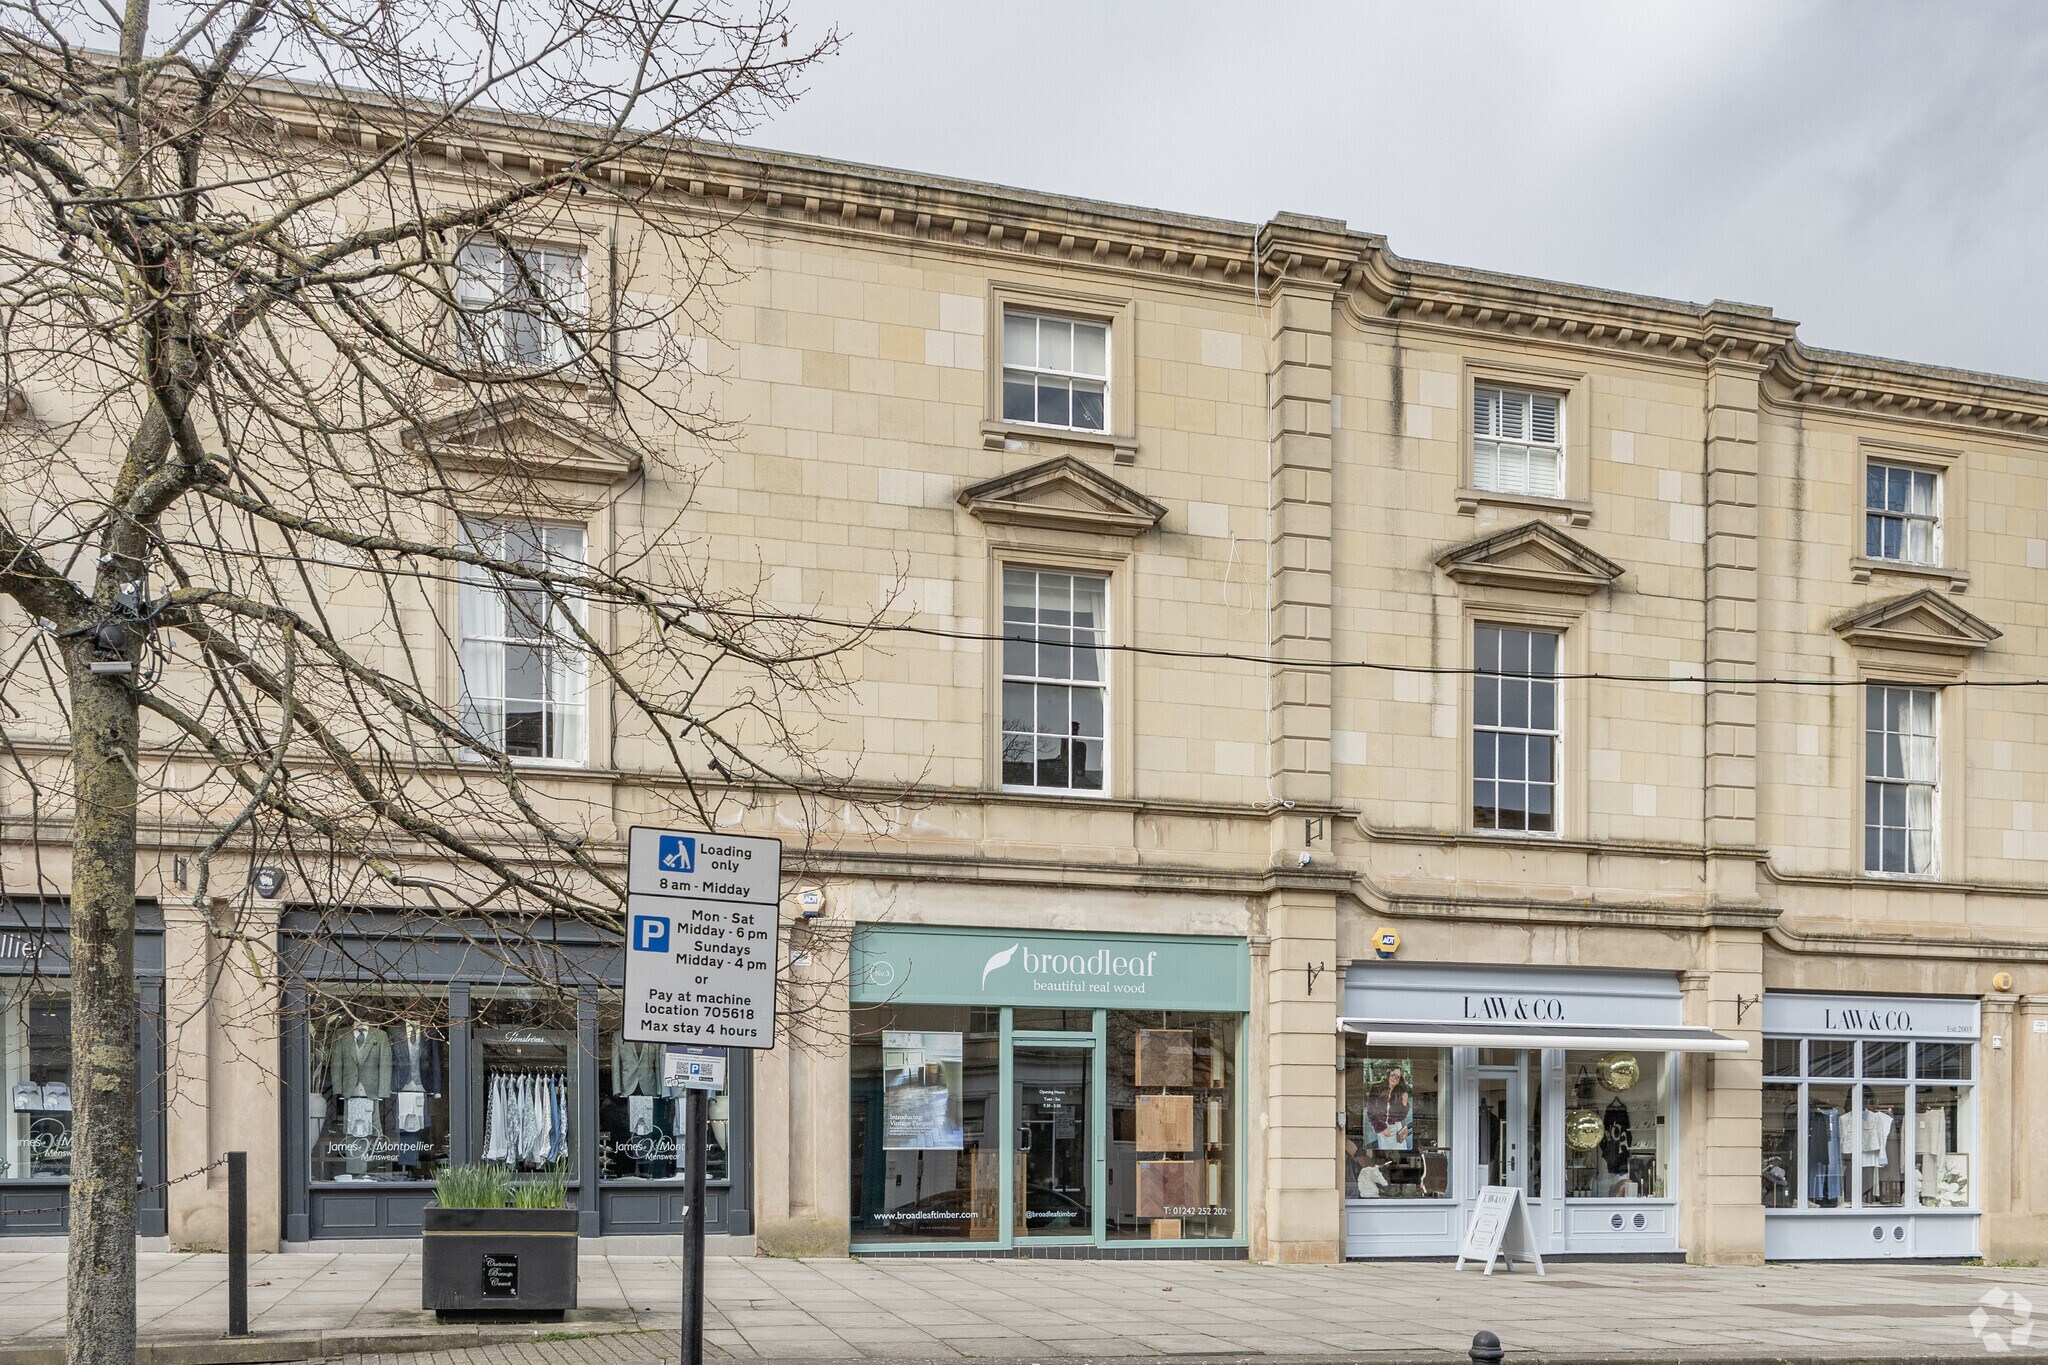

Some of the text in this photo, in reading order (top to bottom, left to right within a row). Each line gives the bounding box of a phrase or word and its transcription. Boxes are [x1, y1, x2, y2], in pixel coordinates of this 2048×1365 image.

[700, 844, 752, 860] Loading
[712, 860, 740, 873] only
[660, 878, 668, 889] 8
[672, 881, 691, 891] am
[702, 881, 750, 897] Midday
[692, 910, 720, 923] Mon
[731, 913, 755, 925] Sat
[641, 920, 665, 948] P
[678, 923, 726, 938] Midday
[736, 928, 744, 938] 6
[748, 930, 768, 942] pm
[1382, 936, 1395, 945] ADT
[694, 941, 750, 956] Sundays
[676, 954, 724, 969] Midday
[734, 959, 744, 969] 4
[747, 962, 767, 972] pm
[1022, 946, 1158, 977] broadleaf
[695, 975, 708, 985] or
[1033, 980, 1146, 993] beautiful real wood
[649, 989, 751, 1006] Pay at machine
[645, 1002, 754, 1020] location 705618
[1464, 996, 1513, 1020] LAW
[1825, 1009, 1867, 1030] LAW
[641, 1020, 758, 1037] Max stay 4 hours
[327, 1141, 358, 1153] James
[376, 1141, 434, 1153] Montpellier
[614, 1141, 643, 1153] James
[874, 1211, 978, 1220] www.broadleaftimber.com
[1025, 1210, 1078, 1219] @broadleaftimber
[1164, 1207, 1227, 1216] T: 01242 252 202
